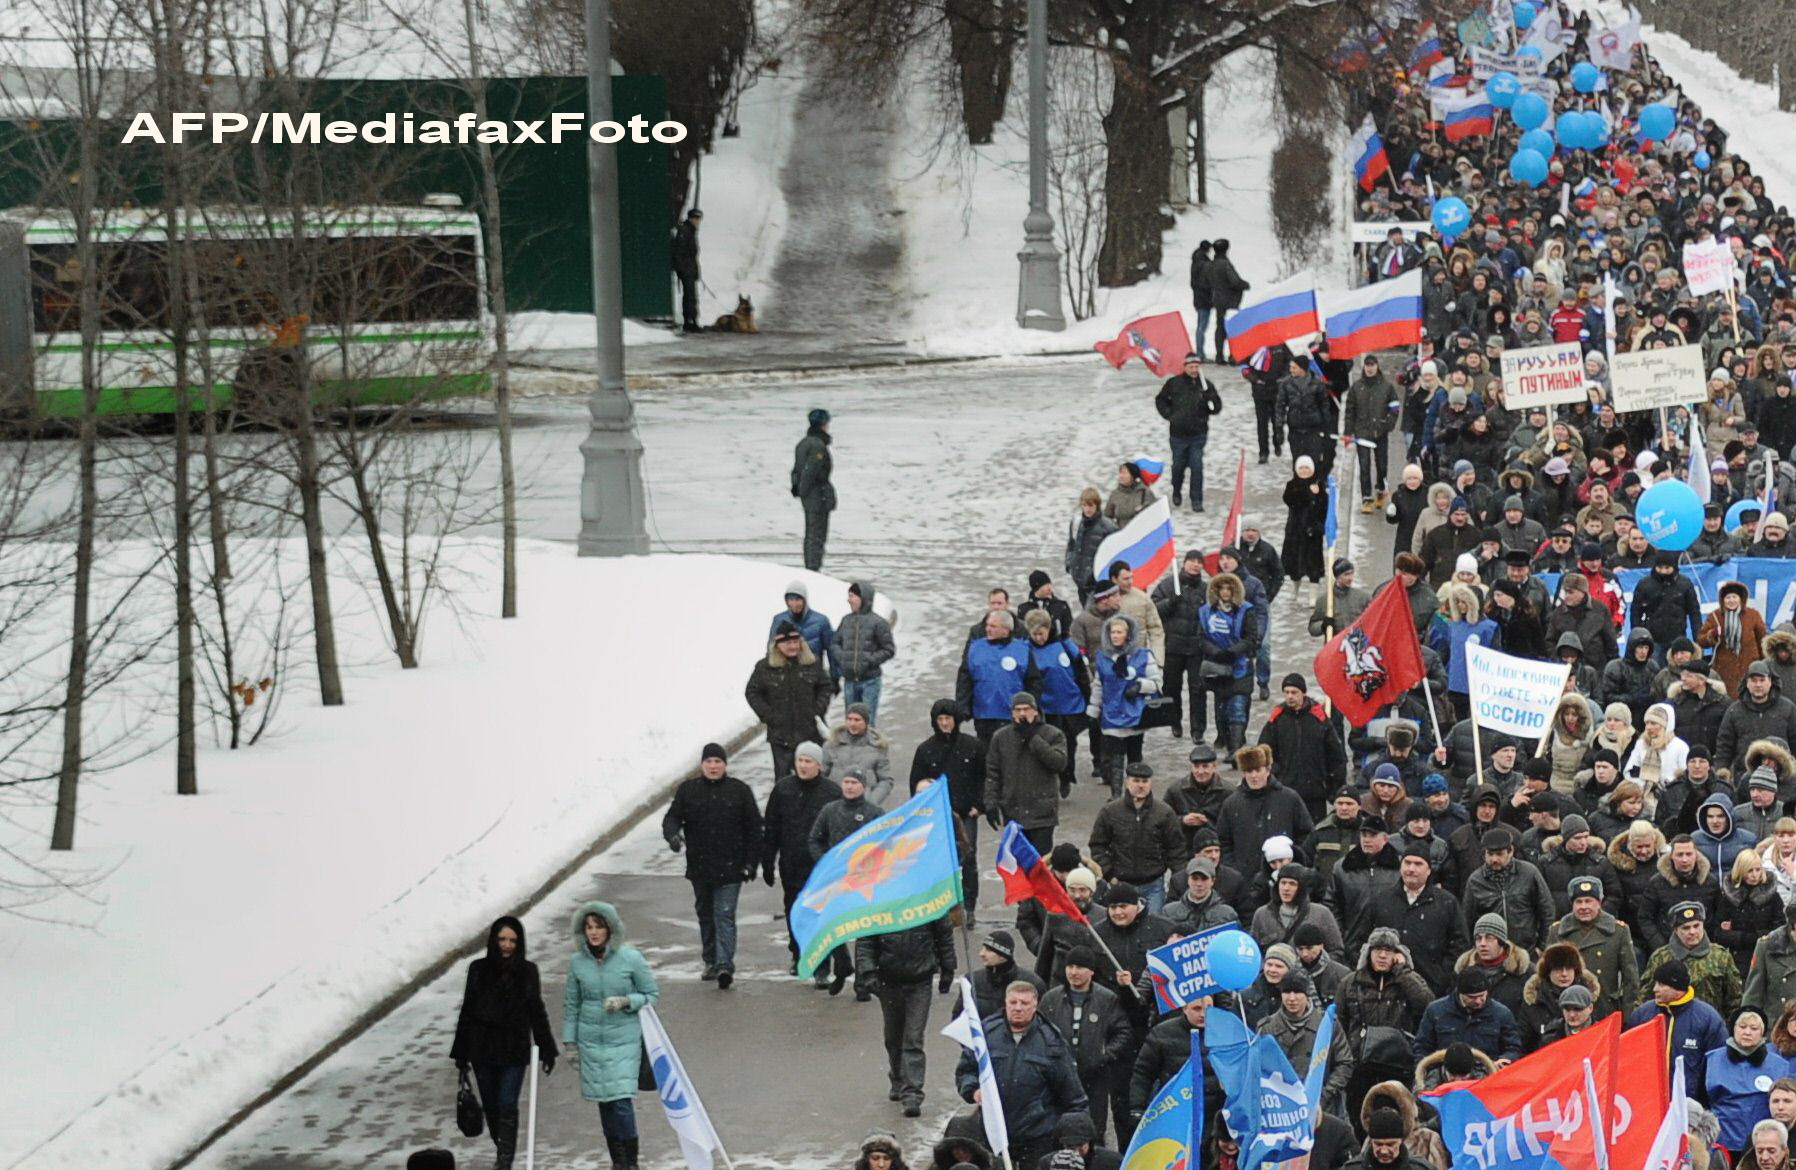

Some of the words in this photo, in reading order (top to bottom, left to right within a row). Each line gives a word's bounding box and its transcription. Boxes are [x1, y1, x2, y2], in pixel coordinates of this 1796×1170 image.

[1519, 370, 1583, 395] ПУТИНЫМ
[1172, 932, 1217, 962] РОССИ
[1178, 977, 1217, 998] СТРА
